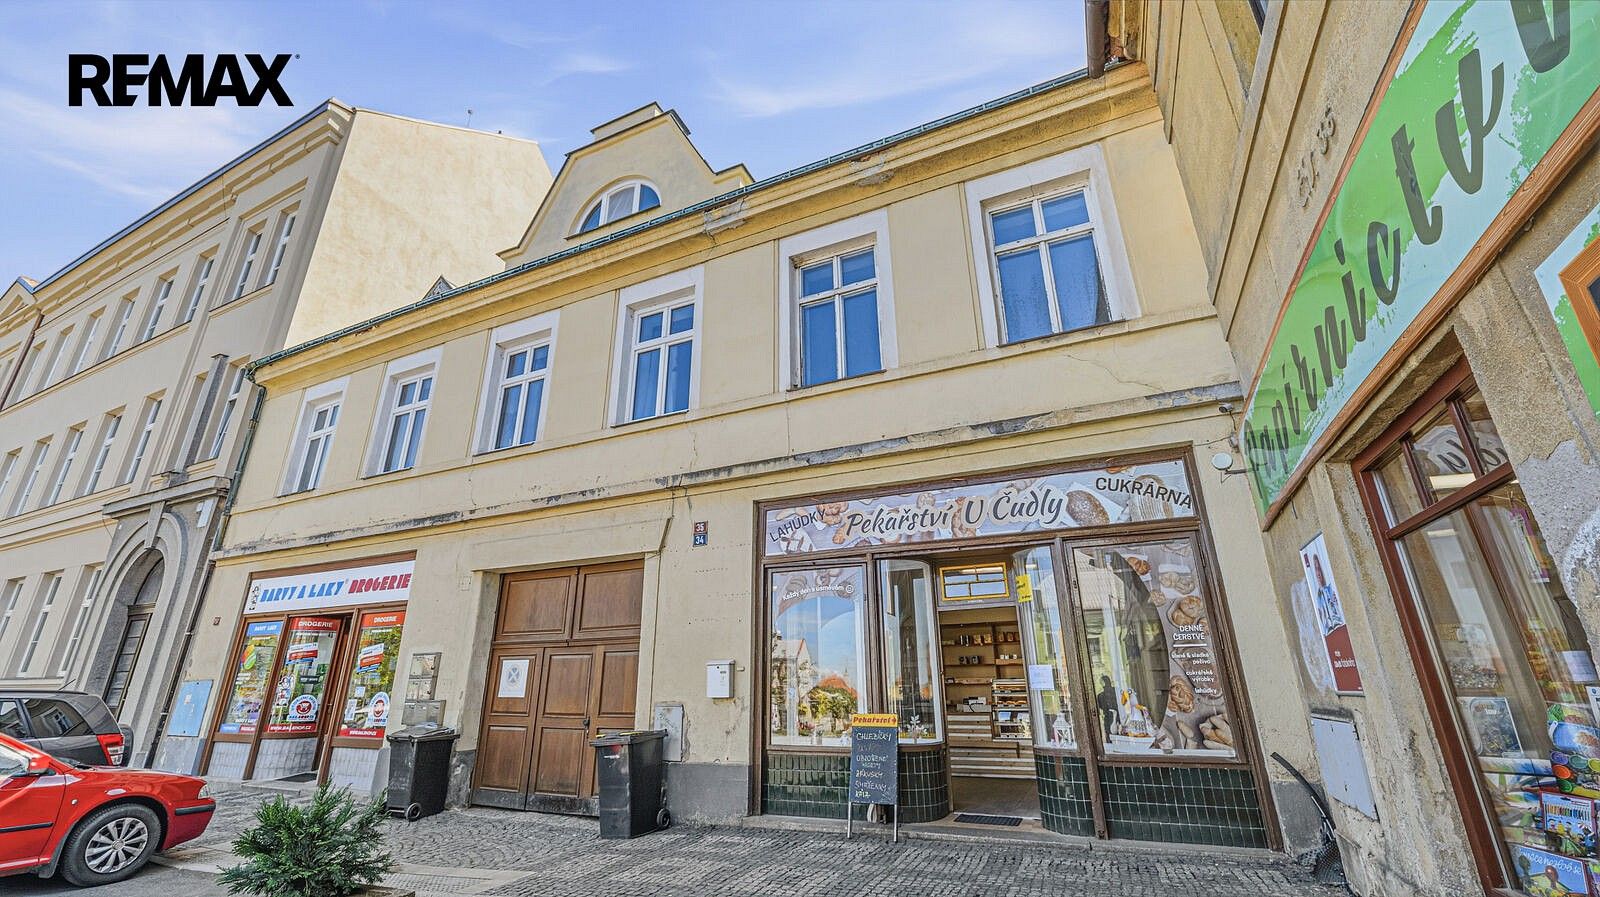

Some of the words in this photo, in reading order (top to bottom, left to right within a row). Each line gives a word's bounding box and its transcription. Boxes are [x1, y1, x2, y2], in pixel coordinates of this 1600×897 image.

[1095, 477, 1192, 510] CUKRÁRNA
[846, 505, 953, 536] Pekařství
[965, 499, 984, 524] U
[992, 489, 1063, 524] Čudly
[695, 523, 705, 532] 35
[695, 536, 704, 545] 34
[260, 586, 297, 603] BARVY
[297, 585, 305, 599] A
[307, 581, 344, 598] LAKY
[348, 573, 412, 594] DROGERIE
[298, 620, 334, 628] DROGERIE
